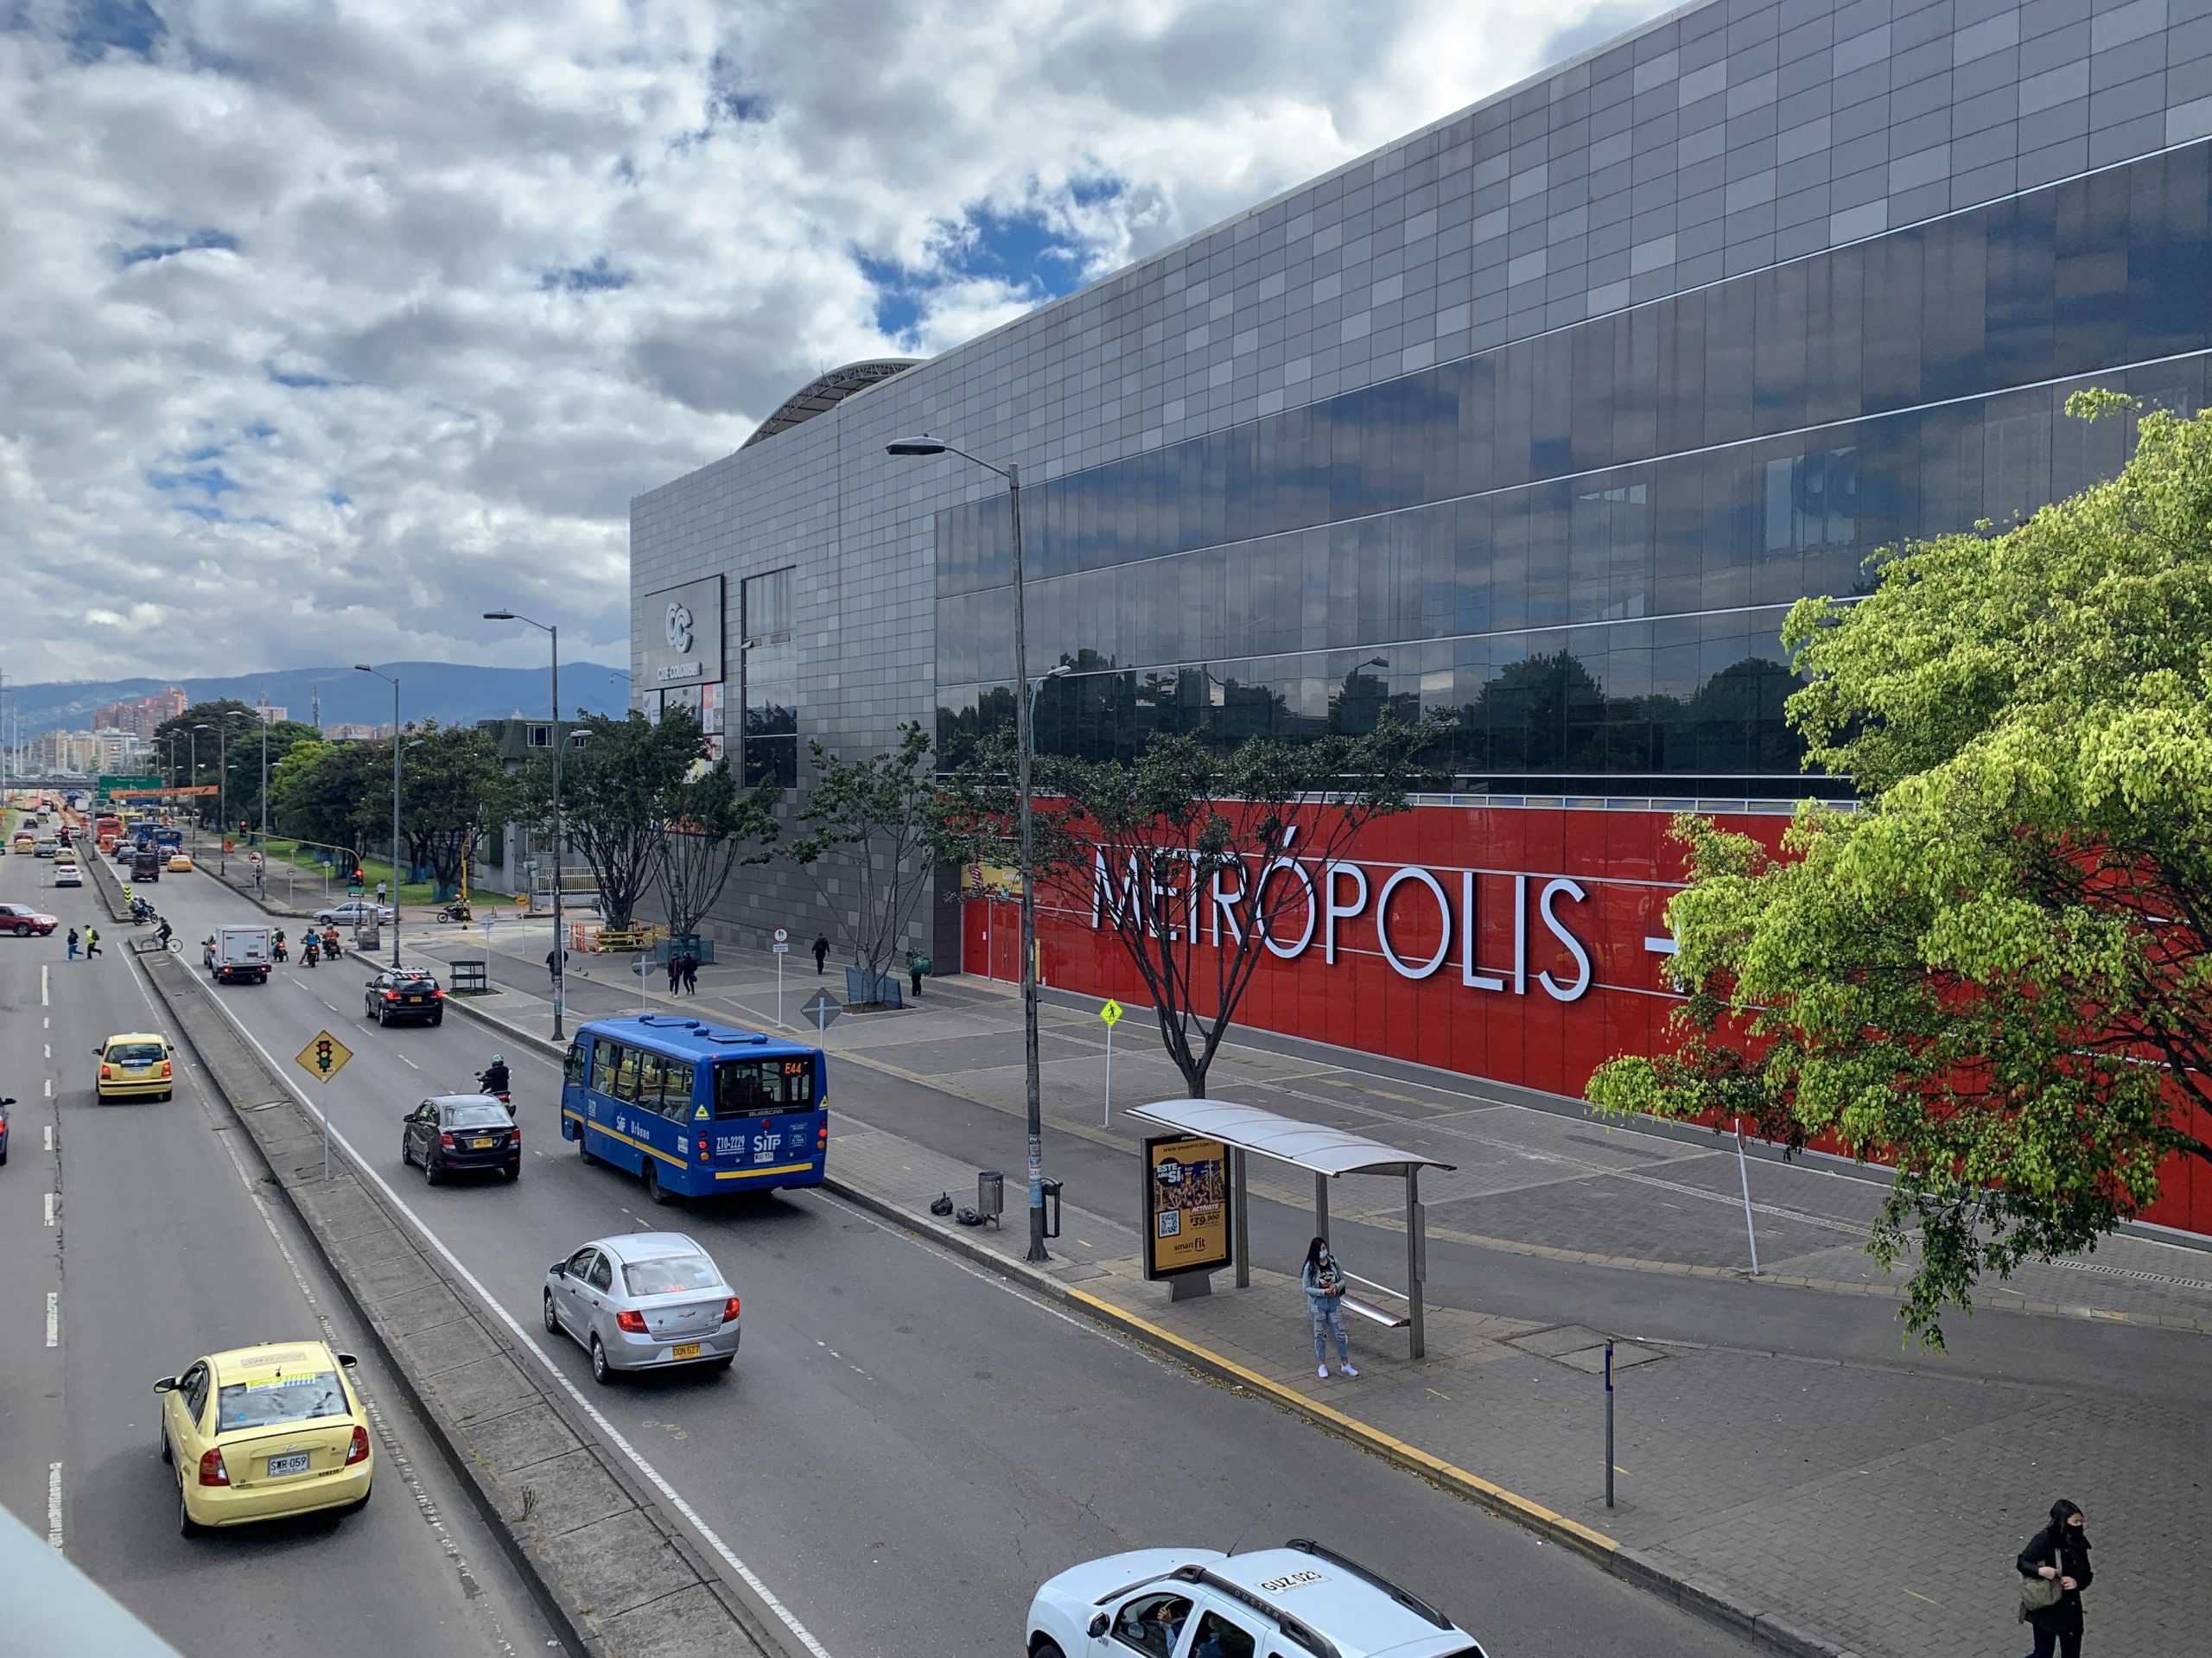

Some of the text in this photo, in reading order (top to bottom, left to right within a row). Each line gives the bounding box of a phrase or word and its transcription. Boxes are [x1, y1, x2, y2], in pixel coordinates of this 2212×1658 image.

[1092, 825, 1591, 1002] METRÓPOLIS
[784, 1062, 802, 1075] E44
[748, 1109, 784, 1117] BUSSCAR
[631, 1120, 650, 1140] Urbano
[716, 1134, 745, 1150] Z10-2229
[1156, 1163, 1178, 1173] ESTE
[1167, 1166, 1182, 1183] SÍ
[270, 1459, 288, 1471] SWR
[289, 1457, 307, 1468] 059
[1261, 1571, 1322, 1591] GUZ 023
[1234, 1590, 1279, 1619] DUSTER
